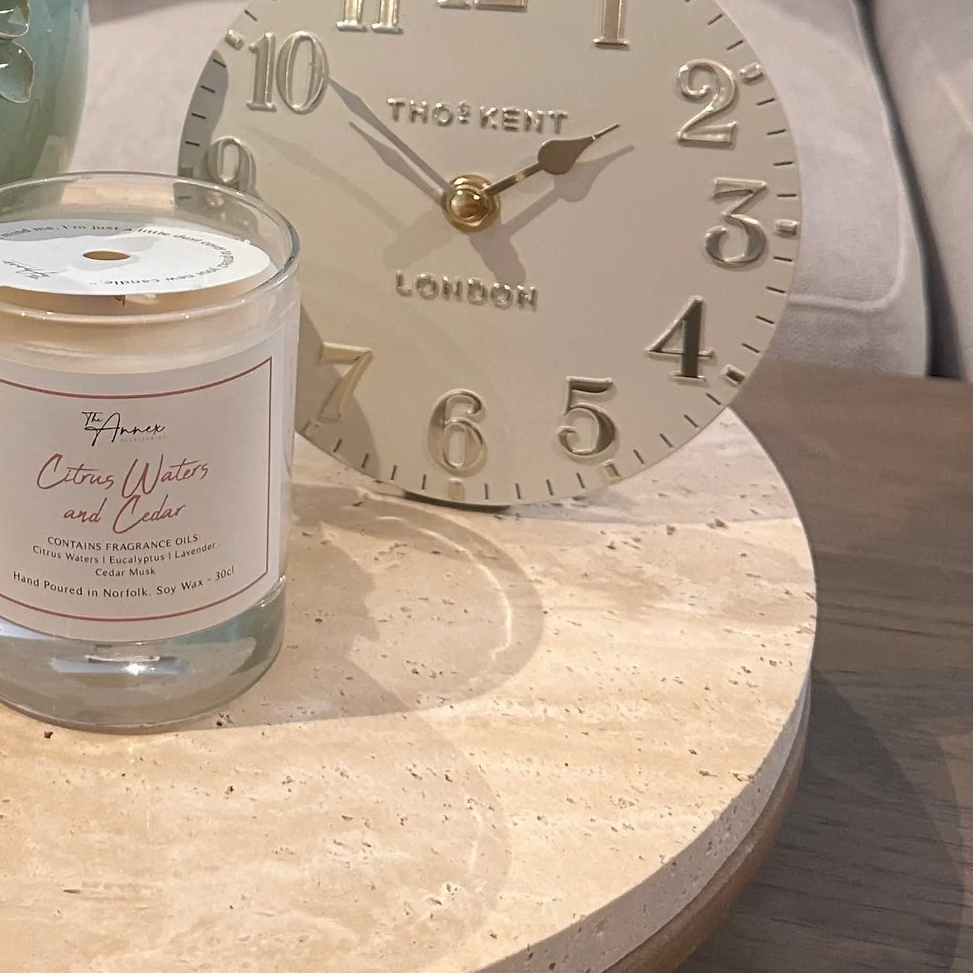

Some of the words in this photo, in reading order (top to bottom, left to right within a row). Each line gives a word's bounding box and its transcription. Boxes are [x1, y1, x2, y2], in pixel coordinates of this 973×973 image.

[247, 30, 329, 114] 10
[480, 107, 569, 134] KENT
[675, 58, 738, 146] 2
[703, 177, 768, 267] 3
[395, 270, 538, 311] LONDON
[644, 297, 713, 382] 4
[320, 343, 373, 425] 7
[81, 411, 103, 426] The
[84, 412, 166, 447] Annex
[428, 389, 485, 473] 6
[558, 376, 616, 459] 5
[36, 452, 115, 490] Citrus
[121, 453, 209, 499] Waters
[63, 497, 108, 523] and
[112, 493, 187, 534] Cedar
[32, 545, 62, 559] Citrus
[65, 552, 99, 564] Waters
[109, 553, 165, 565] Eucalyptus
[47, 536, 102, 551] CONTAINS
[105, 538, 172, 552] FRAGRANCE
[175, 533, 199, 546] OILS
[13, 570, 40, 587] Hand
[43, 580, 83, 596] Poured
[87, 589, 98, 598] in
[156, 585, 177, 595] Soy
[181, 578, 204, 591] Wax
[214, 565, 235, 581] 30cl
[95, 567, 125, 577] Cedar
[129, 567, 156, 577] Musk
